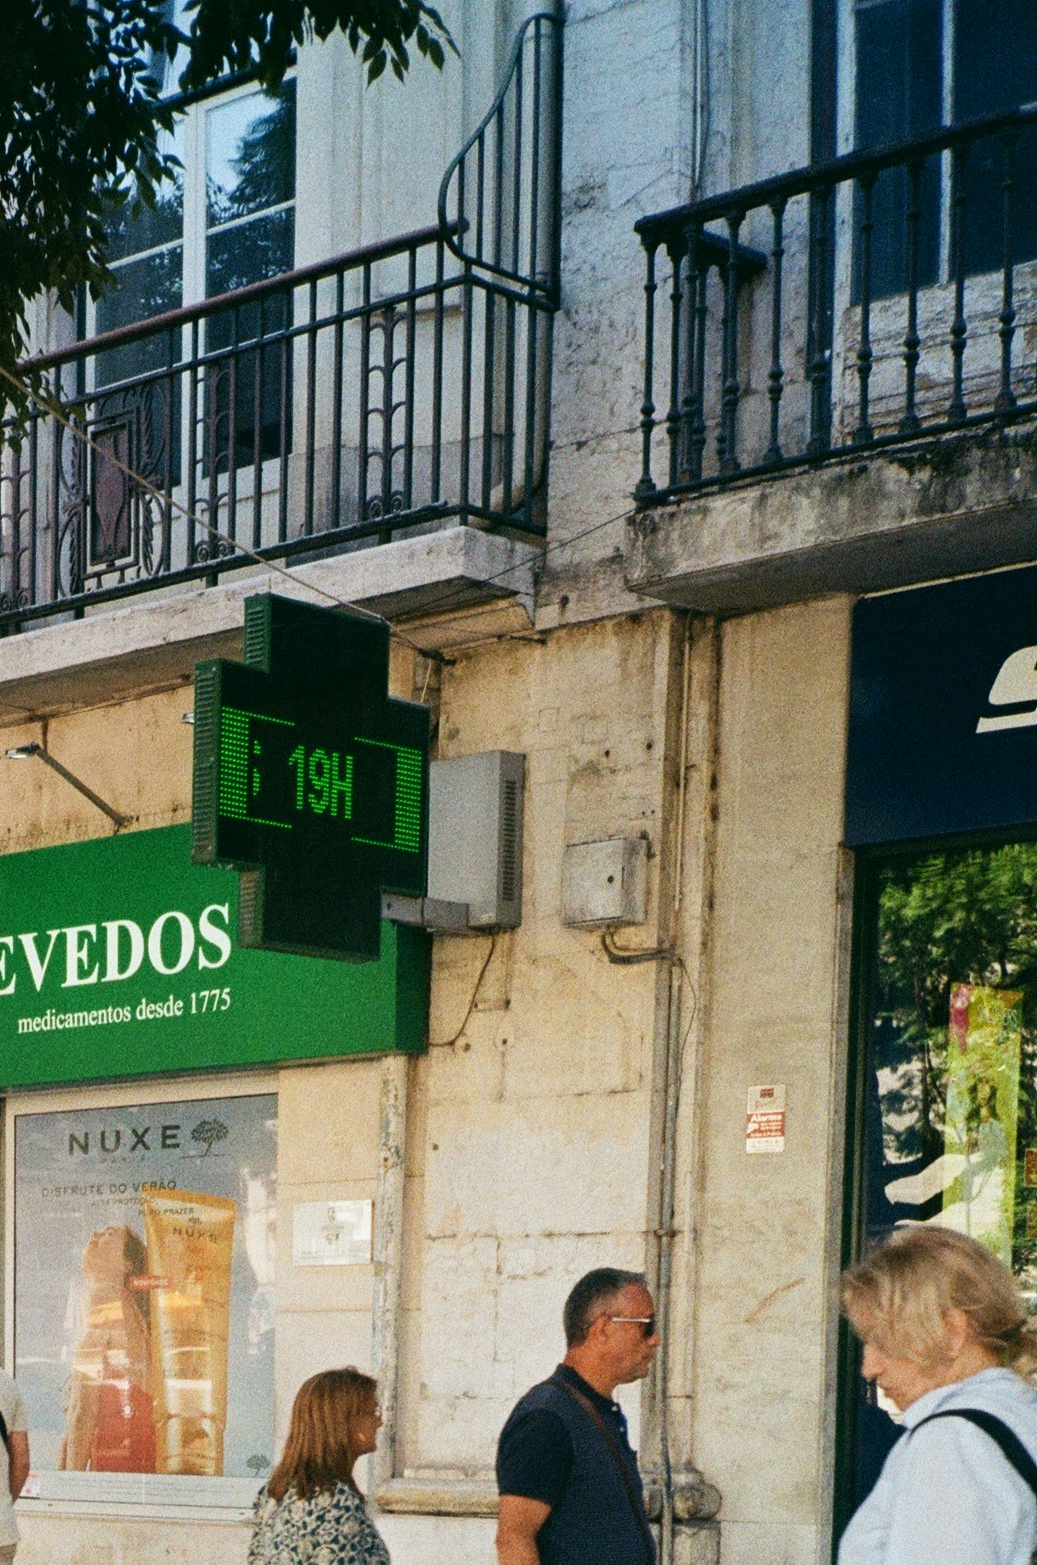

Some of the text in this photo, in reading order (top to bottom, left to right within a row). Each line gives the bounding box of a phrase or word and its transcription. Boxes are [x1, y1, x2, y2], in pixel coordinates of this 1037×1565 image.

[288, 745, 353, 820] 19H
[17, 987, 231, 1034] medicamentos desde 1775
[68, 1124, 182, 1156] NUXE
[41, 1177, 177, 1198] DISFRUTE DO VERÃO
